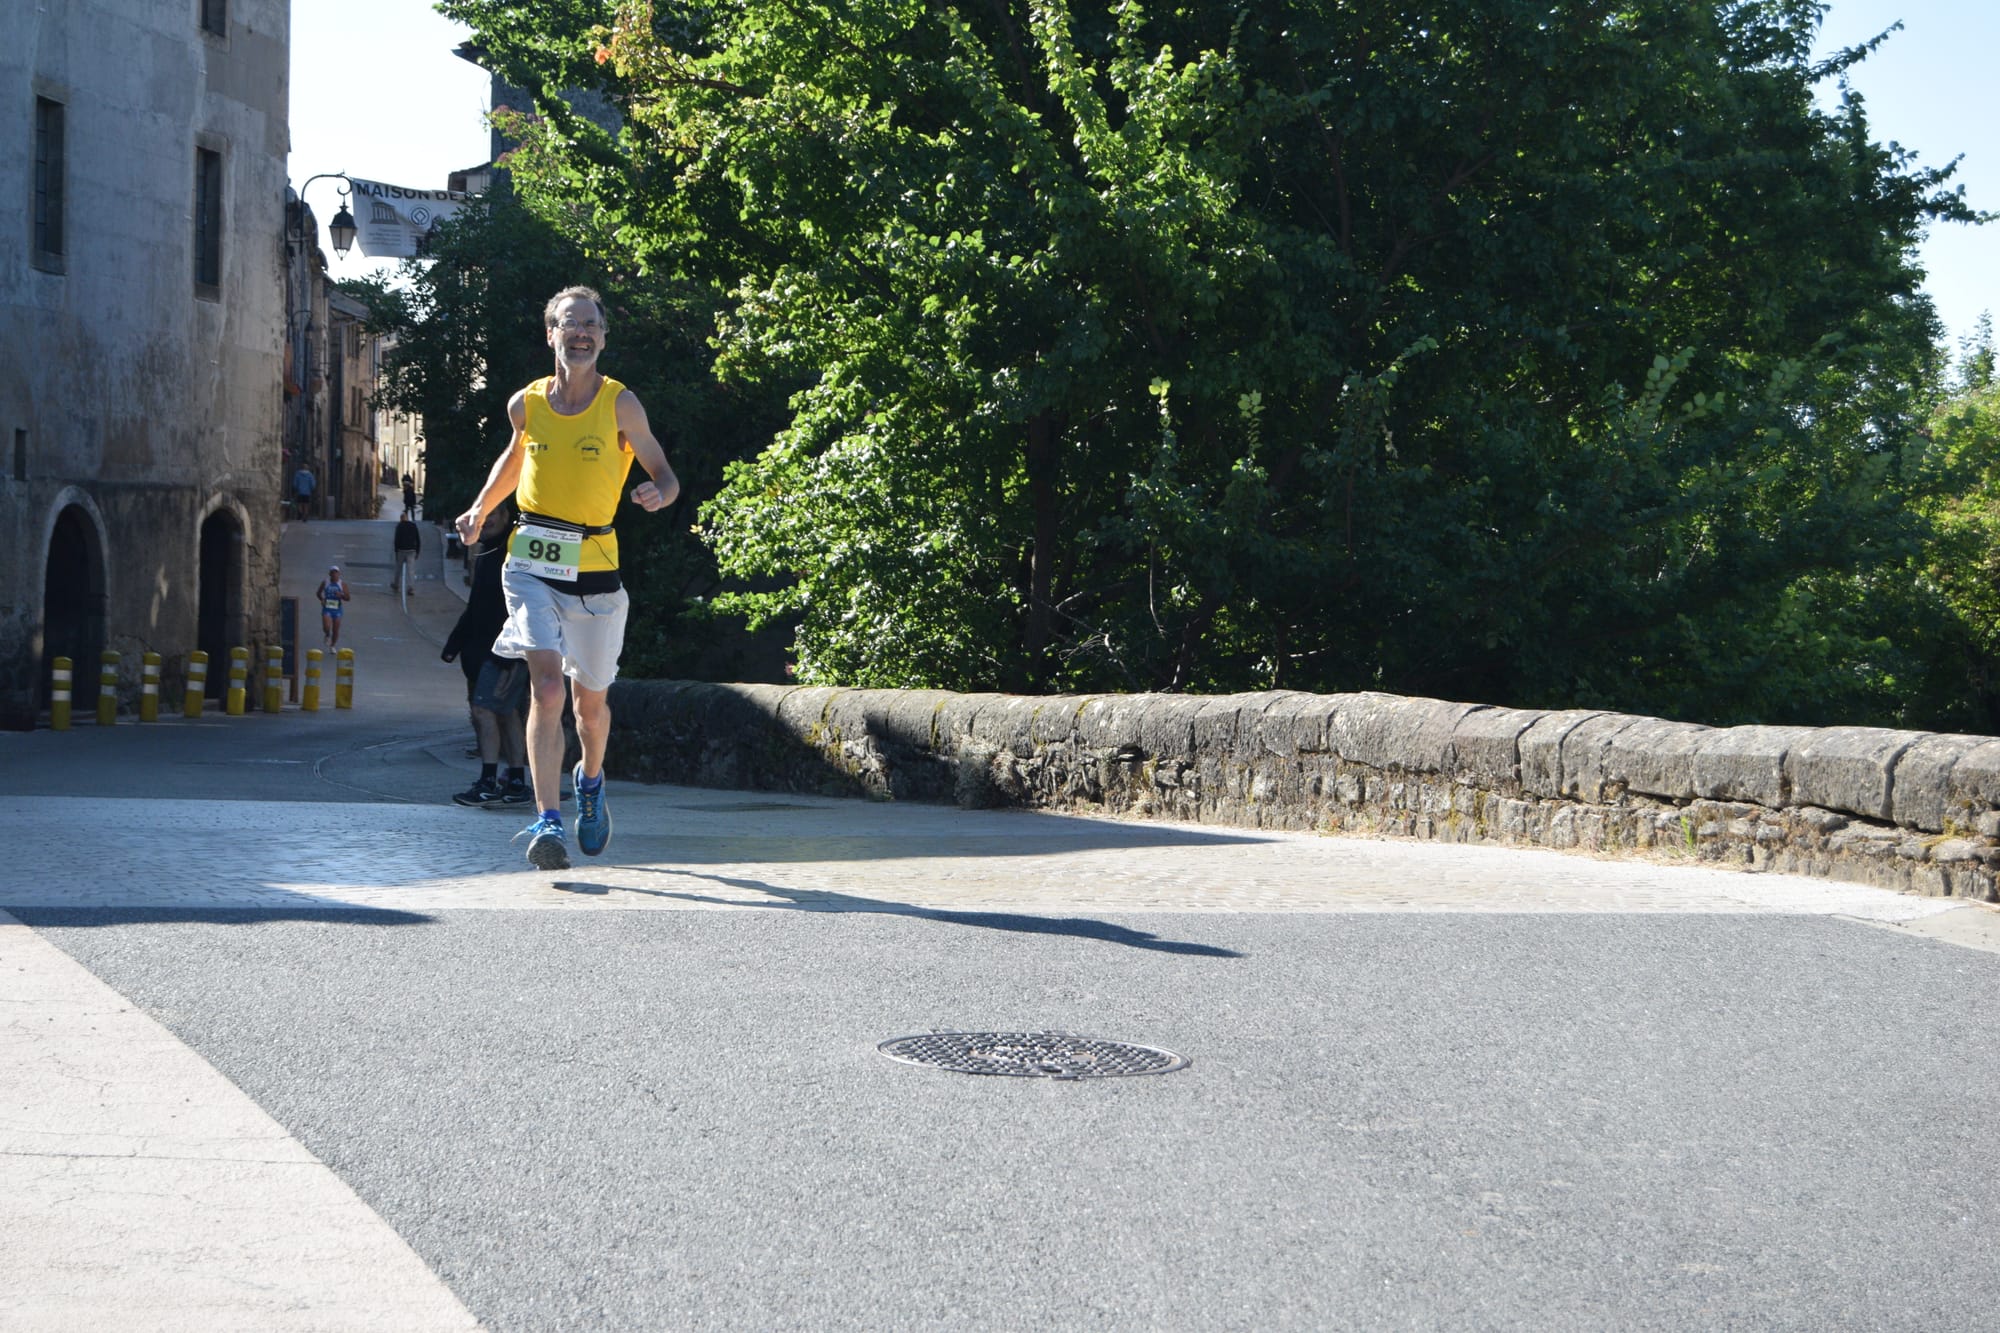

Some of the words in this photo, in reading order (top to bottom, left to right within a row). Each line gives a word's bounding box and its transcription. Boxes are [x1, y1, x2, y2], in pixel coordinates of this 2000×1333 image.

[356, 183, 429, 200] MAISON
[435, 191, 458, 201] DE
[528, 539, 561, 563] 98
